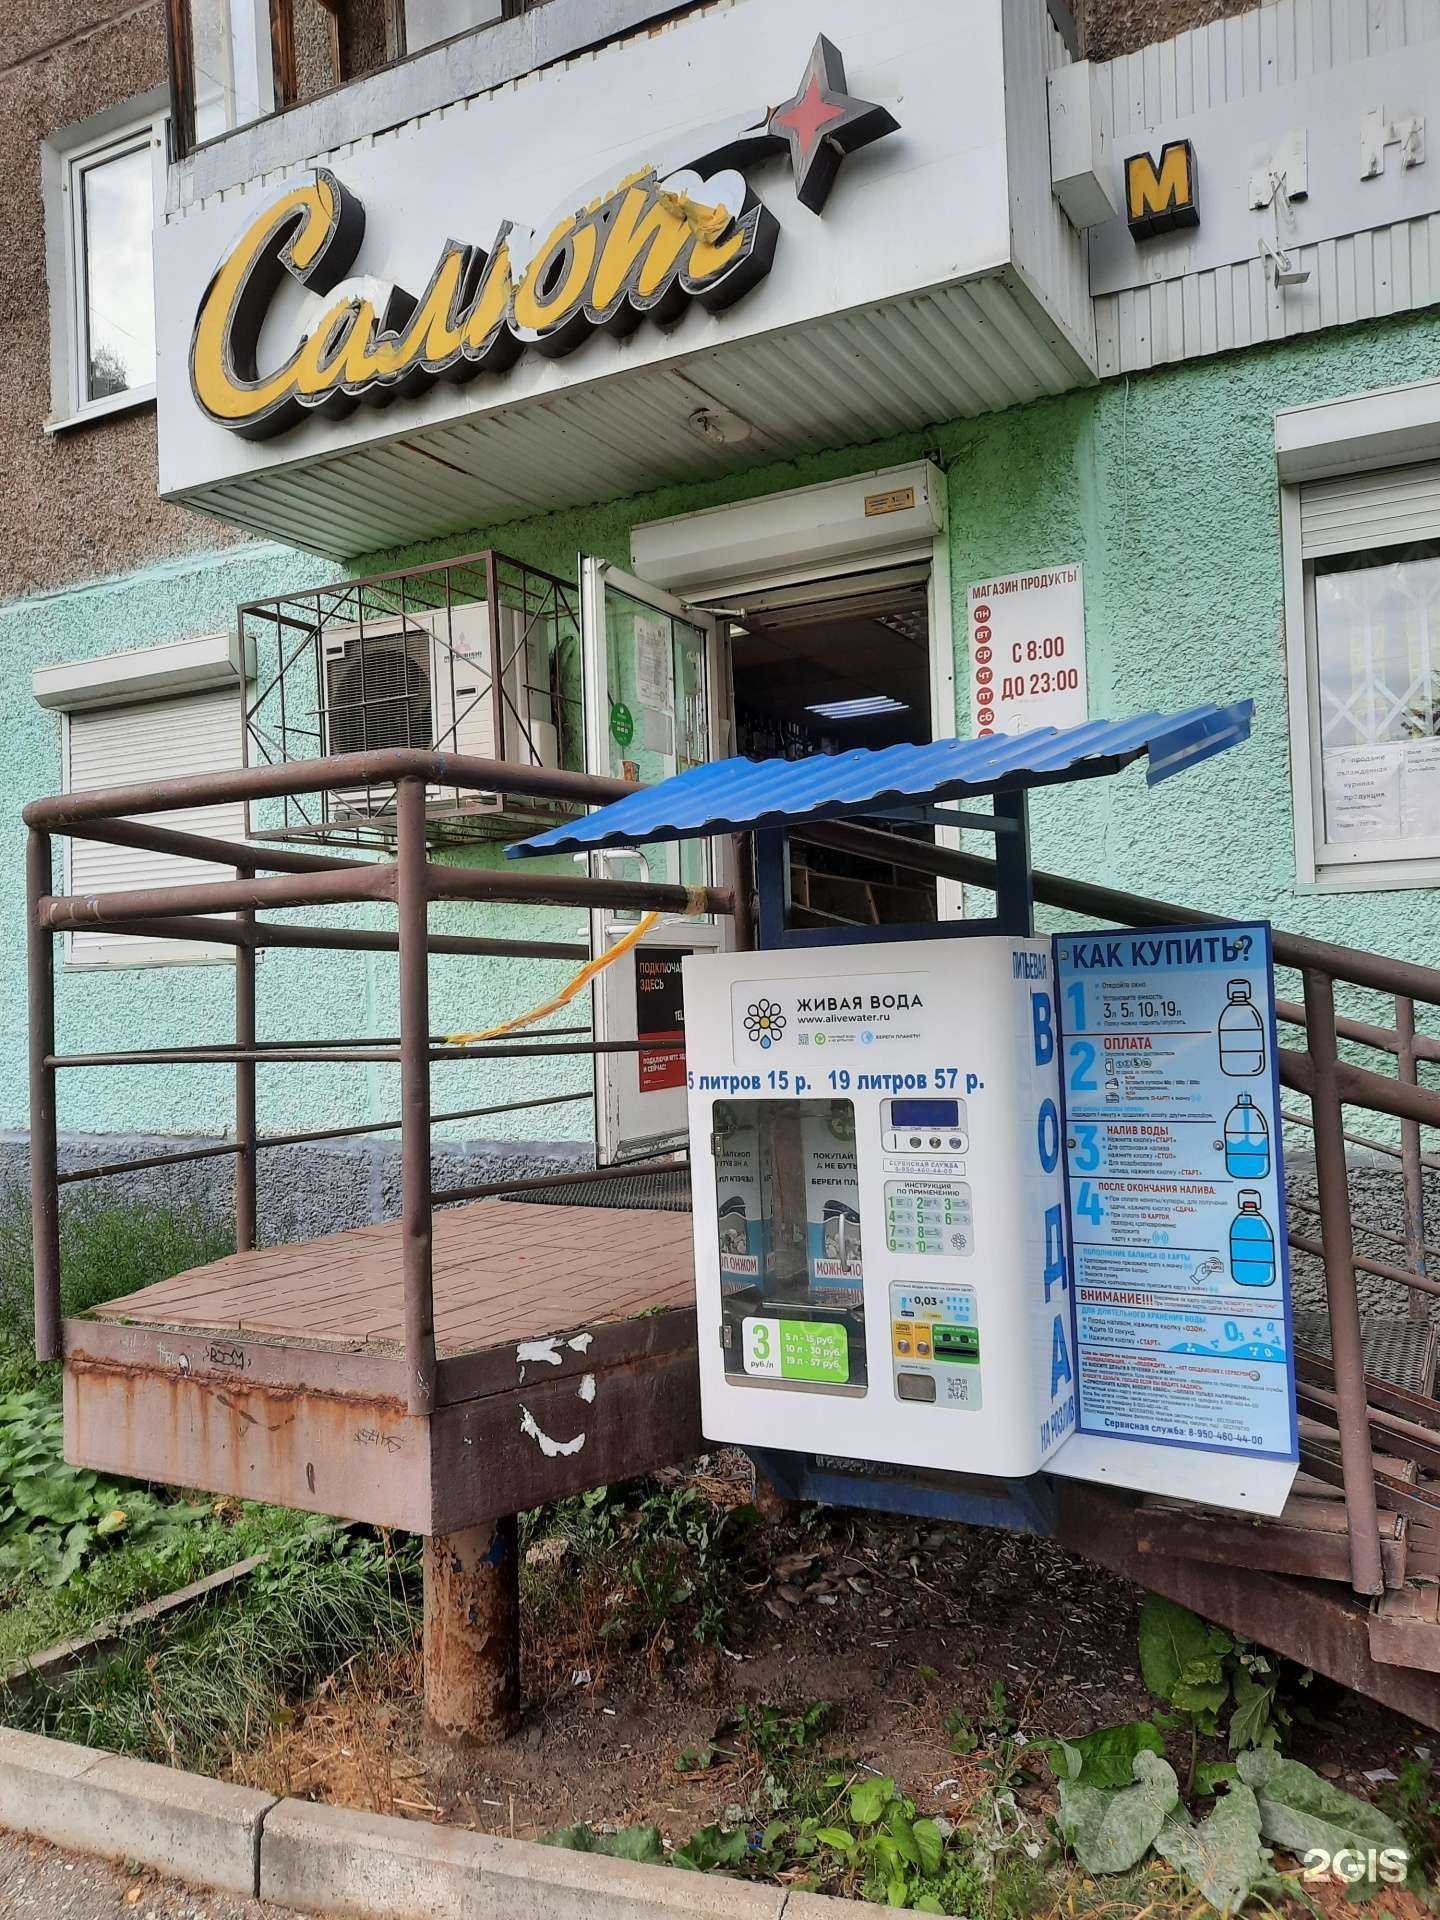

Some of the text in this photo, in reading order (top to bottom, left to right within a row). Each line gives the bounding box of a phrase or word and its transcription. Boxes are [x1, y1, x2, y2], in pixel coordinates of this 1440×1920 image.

[189, 166, 778, 438] Салют
[972, 570, 1077, 599] МАГАЗИН ПРОДУКТЫ
[1012, 636, 1065, 663] С 8:00
[1001, 668, 1078, 701] ДО 23:00
[1072, 934, 1253, 969] КАК КУПИТЬ?
[639, 978, 665, 992] ЗДЕСЬ
[797, 994, 924, 1013] ЖИВАЯ ВОДА
[1067, 981, 1086, 1031] 1
[674, 1009, 685, 1022] TEL
[797, 1013, 890, 1024] www.alivewater.ru
[1103, 1037, 1153, 1051] ОПЛАТА
[1070, 1041, 1098, 1091] 2
[699, 1074, 761, 1094] литров
[768, 1070, 789, 1090] 15
[795, 1075, 811, 1095] р.
[828, 1069, 850, 1090] 19
[857, 1073, 927, 1094] литров
[935, 1068, 958, 1089] 57
[966, 1073, 985, 1094] р.
[1107, 1125, 1169, 1136] НАЛИВ ВОДЫ
[1074, 1125, 1100, 1171] 3
[813, 1151, 854, 1160] ПОКУПАЙ
[811, 1178, 842, 1186] БЕРЕГИ
[904, 1181, 952, 1190] ИНСТРУКЦИЯ
[1098, 1182, 1125, 1192] ПОСЛЕ
[1127, 1183, 1178, 1194] ОКОНЧАНИЯ
[908, 1189, 960, 1197] ПРИМЕНЕНИЮ
[917, 1197, 924, 1209] 2
[944, 1198, 951, 1210] 3
[1077, 1181, 1104, 1226] 4
[888, 1210, 952, 1225] 4 5 6
[917, 1226, 925, 1238] 8
[890, 1239, 897, 1251] 9
[816, 1261, 848, 1276] МОЖН
[914, 1296, 938, 1307] 0,03
[1080, 1289, 1153, 1306] ВНИМАНИЕ!!!
[752, 1324, 770, 1360] 3
[806, 1334, 814, 1342] 15
[785, 1344, 795, 1353] 10
[1104, 1417, 1150, 1432] Сервисная
[1188, 1427, 1263, 1446] 8-950-460-44-00
